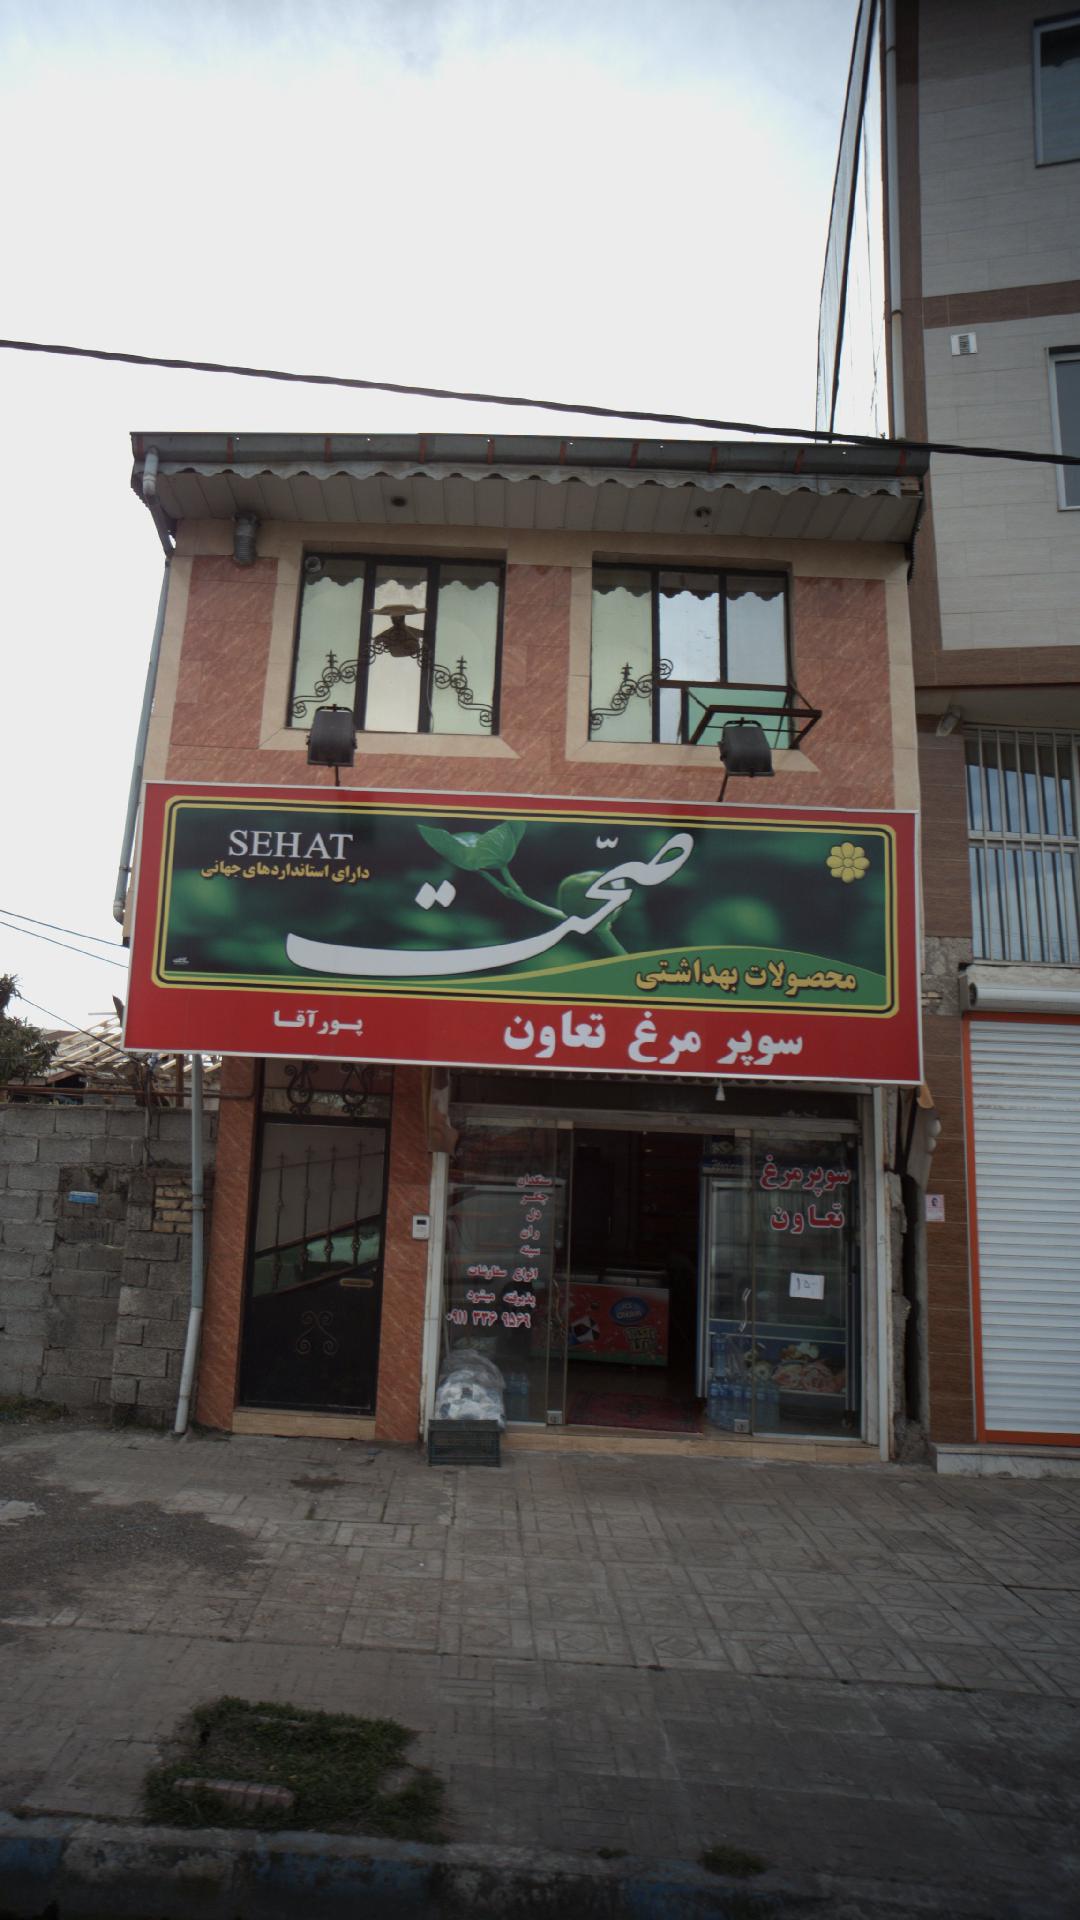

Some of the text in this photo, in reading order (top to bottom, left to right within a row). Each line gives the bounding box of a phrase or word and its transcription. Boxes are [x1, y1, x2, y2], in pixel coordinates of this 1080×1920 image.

[228, 829, 354, 860] SEHAT
[201, 860, 370, 882] دارای استانداردهای جهانی
[635, 958, 857, 997] محصولات بهداشتی
[503, 1011, 803, 1067] سوپر مرغ تعاون
[760, 1154, 851, 1196] سوپر مرغ
[770, 1203, 845, 1234] تعاون
